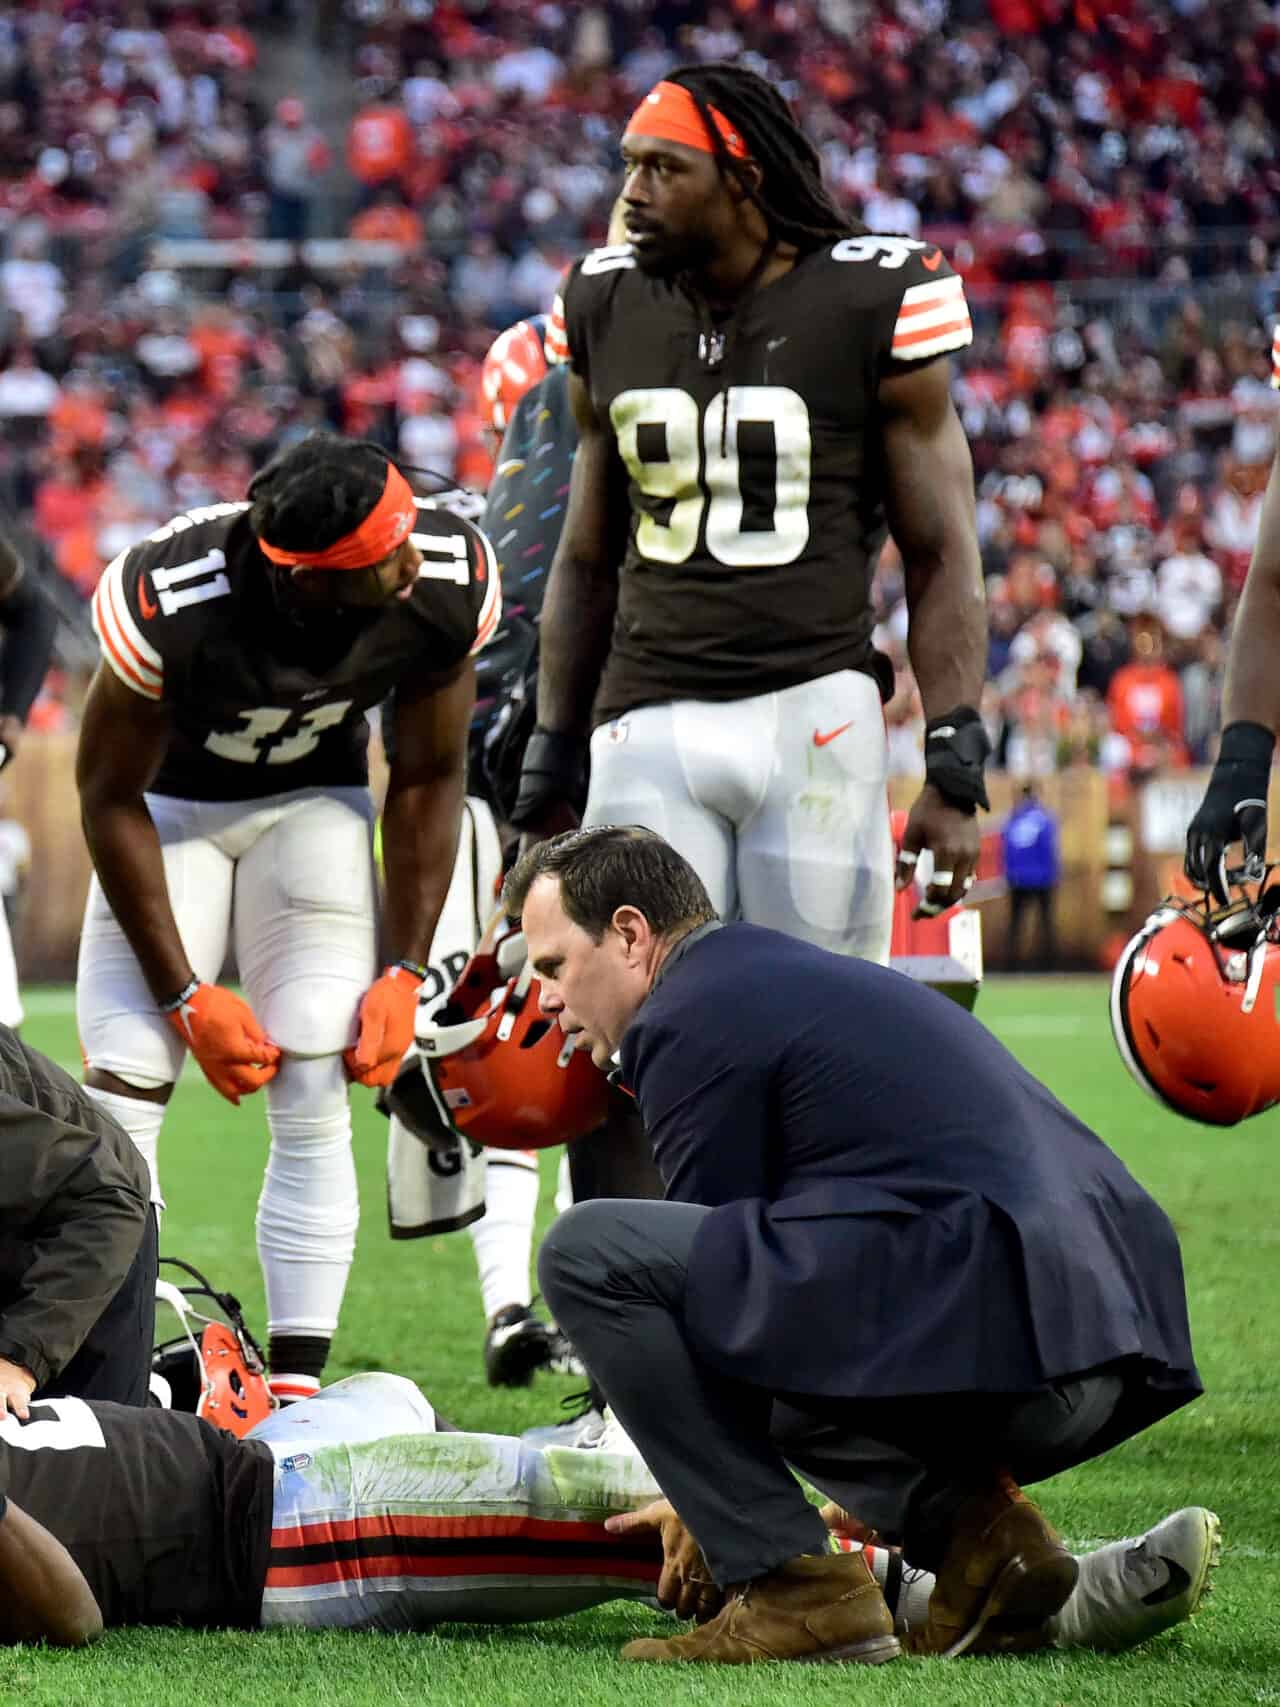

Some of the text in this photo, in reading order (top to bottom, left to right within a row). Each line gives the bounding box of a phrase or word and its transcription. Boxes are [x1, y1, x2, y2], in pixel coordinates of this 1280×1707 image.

[610, 386, 811, 567] 90
[150, 548, 231, 616] 11
[204, 700, 353, 765] 11
